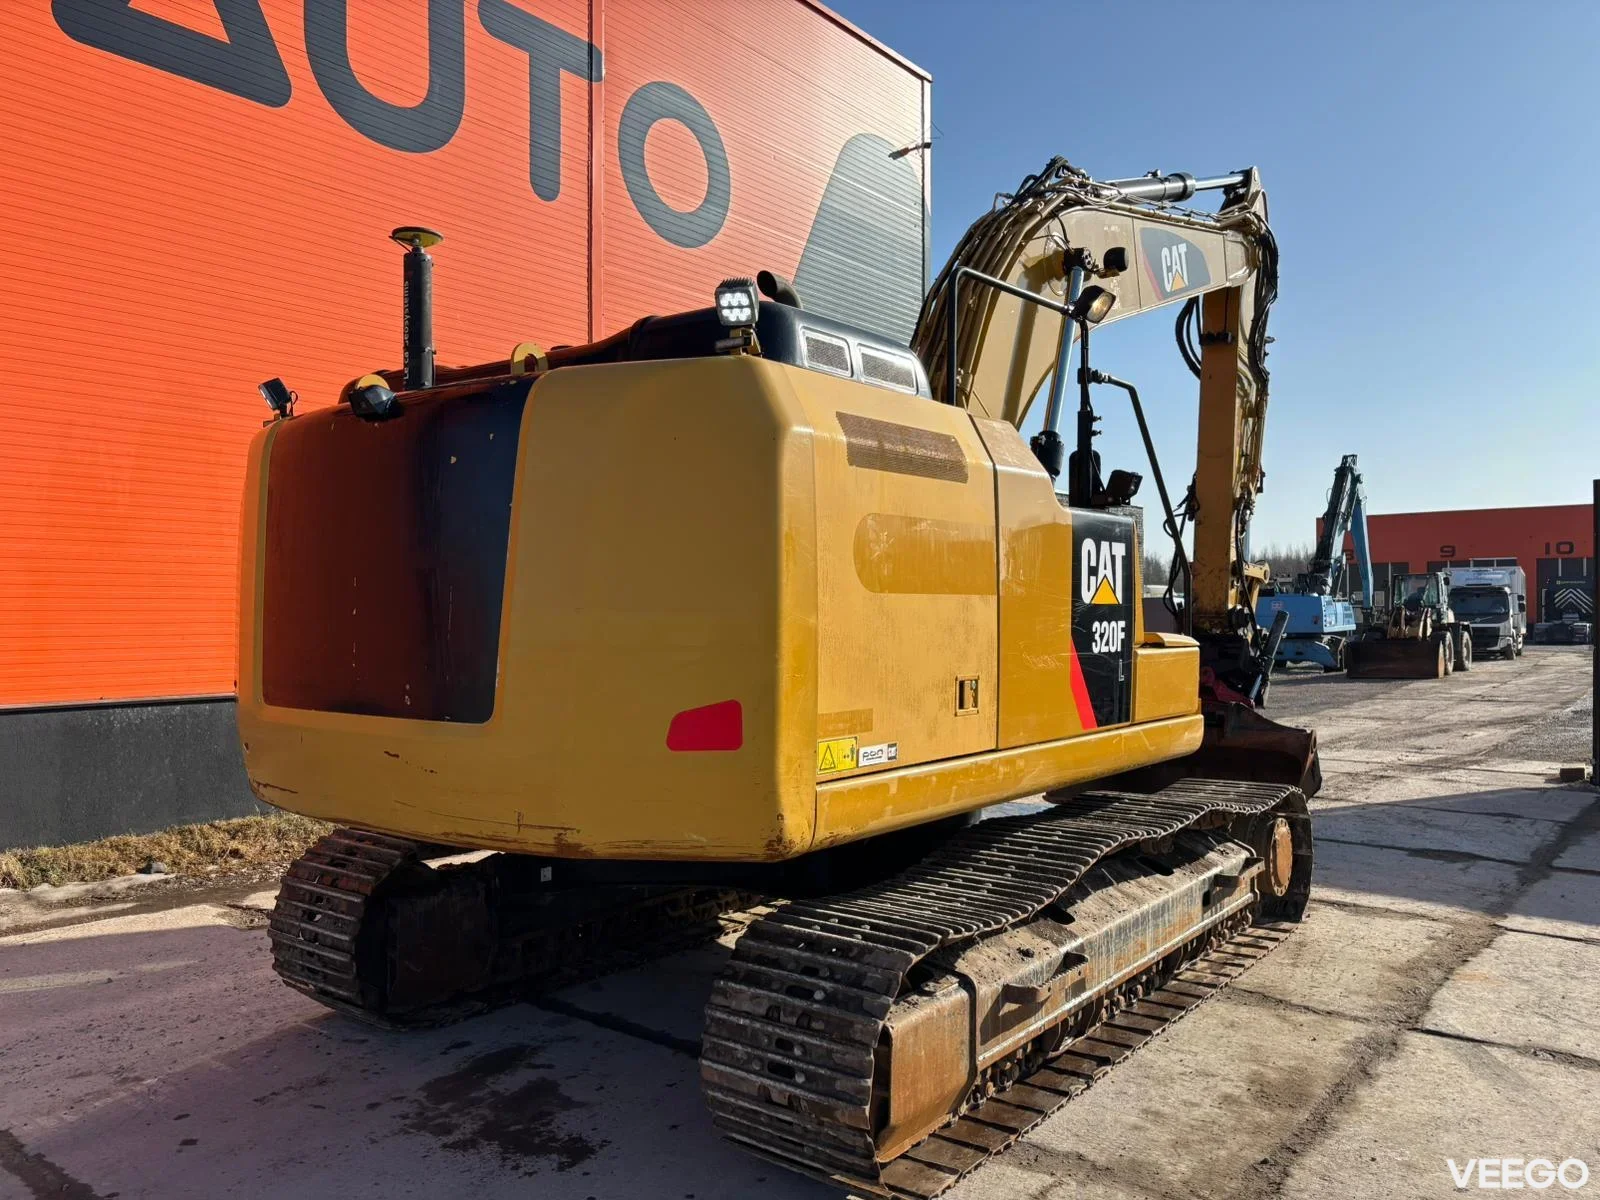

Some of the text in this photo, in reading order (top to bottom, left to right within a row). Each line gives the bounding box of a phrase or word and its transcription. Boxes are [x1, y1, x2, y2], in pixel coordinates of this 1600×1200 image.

[1161, 243, 1188, 292] CAT
[1440, 545, 1455, 557] 9
[1545, 541, 1574, 555] 10
[1081, 537, 1126, 604] CAT
[1092, 620, 1126, 653] 320F
[1118, 659, 1125, 681] L
